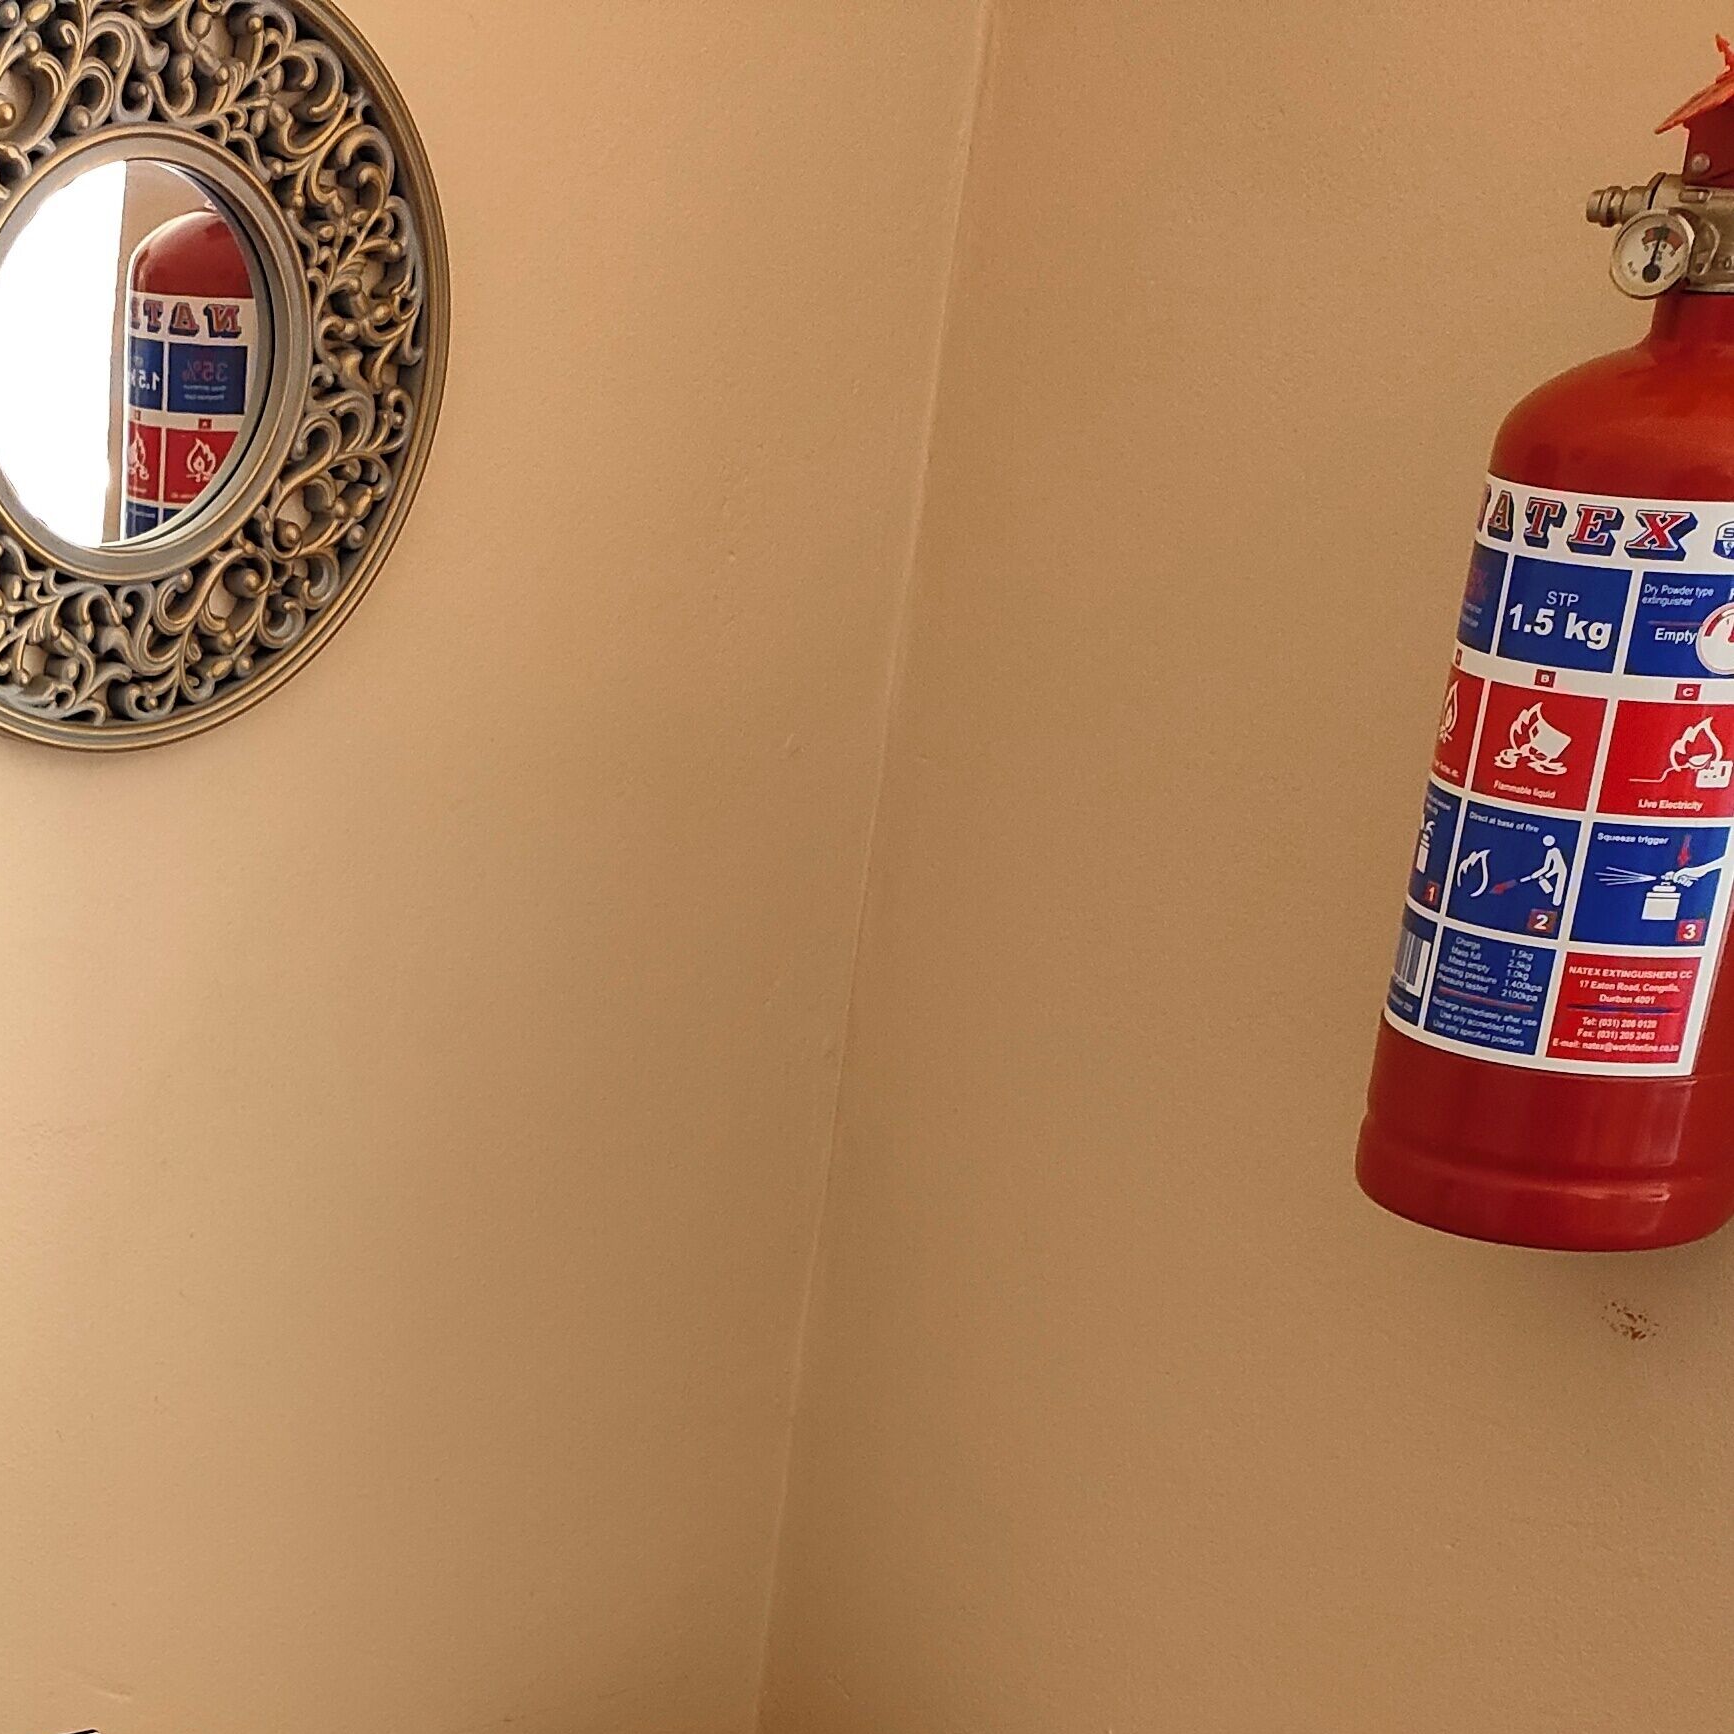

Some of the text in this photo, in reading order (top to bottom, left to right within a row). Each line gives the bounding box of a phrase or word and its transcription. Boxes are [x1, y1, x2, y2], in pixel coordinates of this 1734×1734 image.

[1477, 484, 1698, 561] ATEX
[1644, 583, 1714, 598] Dry Powder type
[1546, 590, 1579, 607] STP
[1642, 596, 1693, 607] extinguisher
[1509, 603, 1613, 651] 1.5 kg
[1655, 627, 1697, 645] Empty
[1493, 779, 1556, 799] Flammable liquid
[1638, 799, 1704, 811] Live Electricity
[1526, 823, 1539, 833] fire
[1597, 832, 1669, 845] Squeeze trigger
[1534, 915, 1549, 930] 2
[1684, 924, 1697, 938] 3
[1467, 962, 1490, 974] empty
[1569, 966, 1694, 979] NATEX EXTINGUISHERS CC
[1579, 980, 1589, 988] 17
[1599, 994, 1633, 1004] Durban
[1522, 1019, 1538, 1027] use
